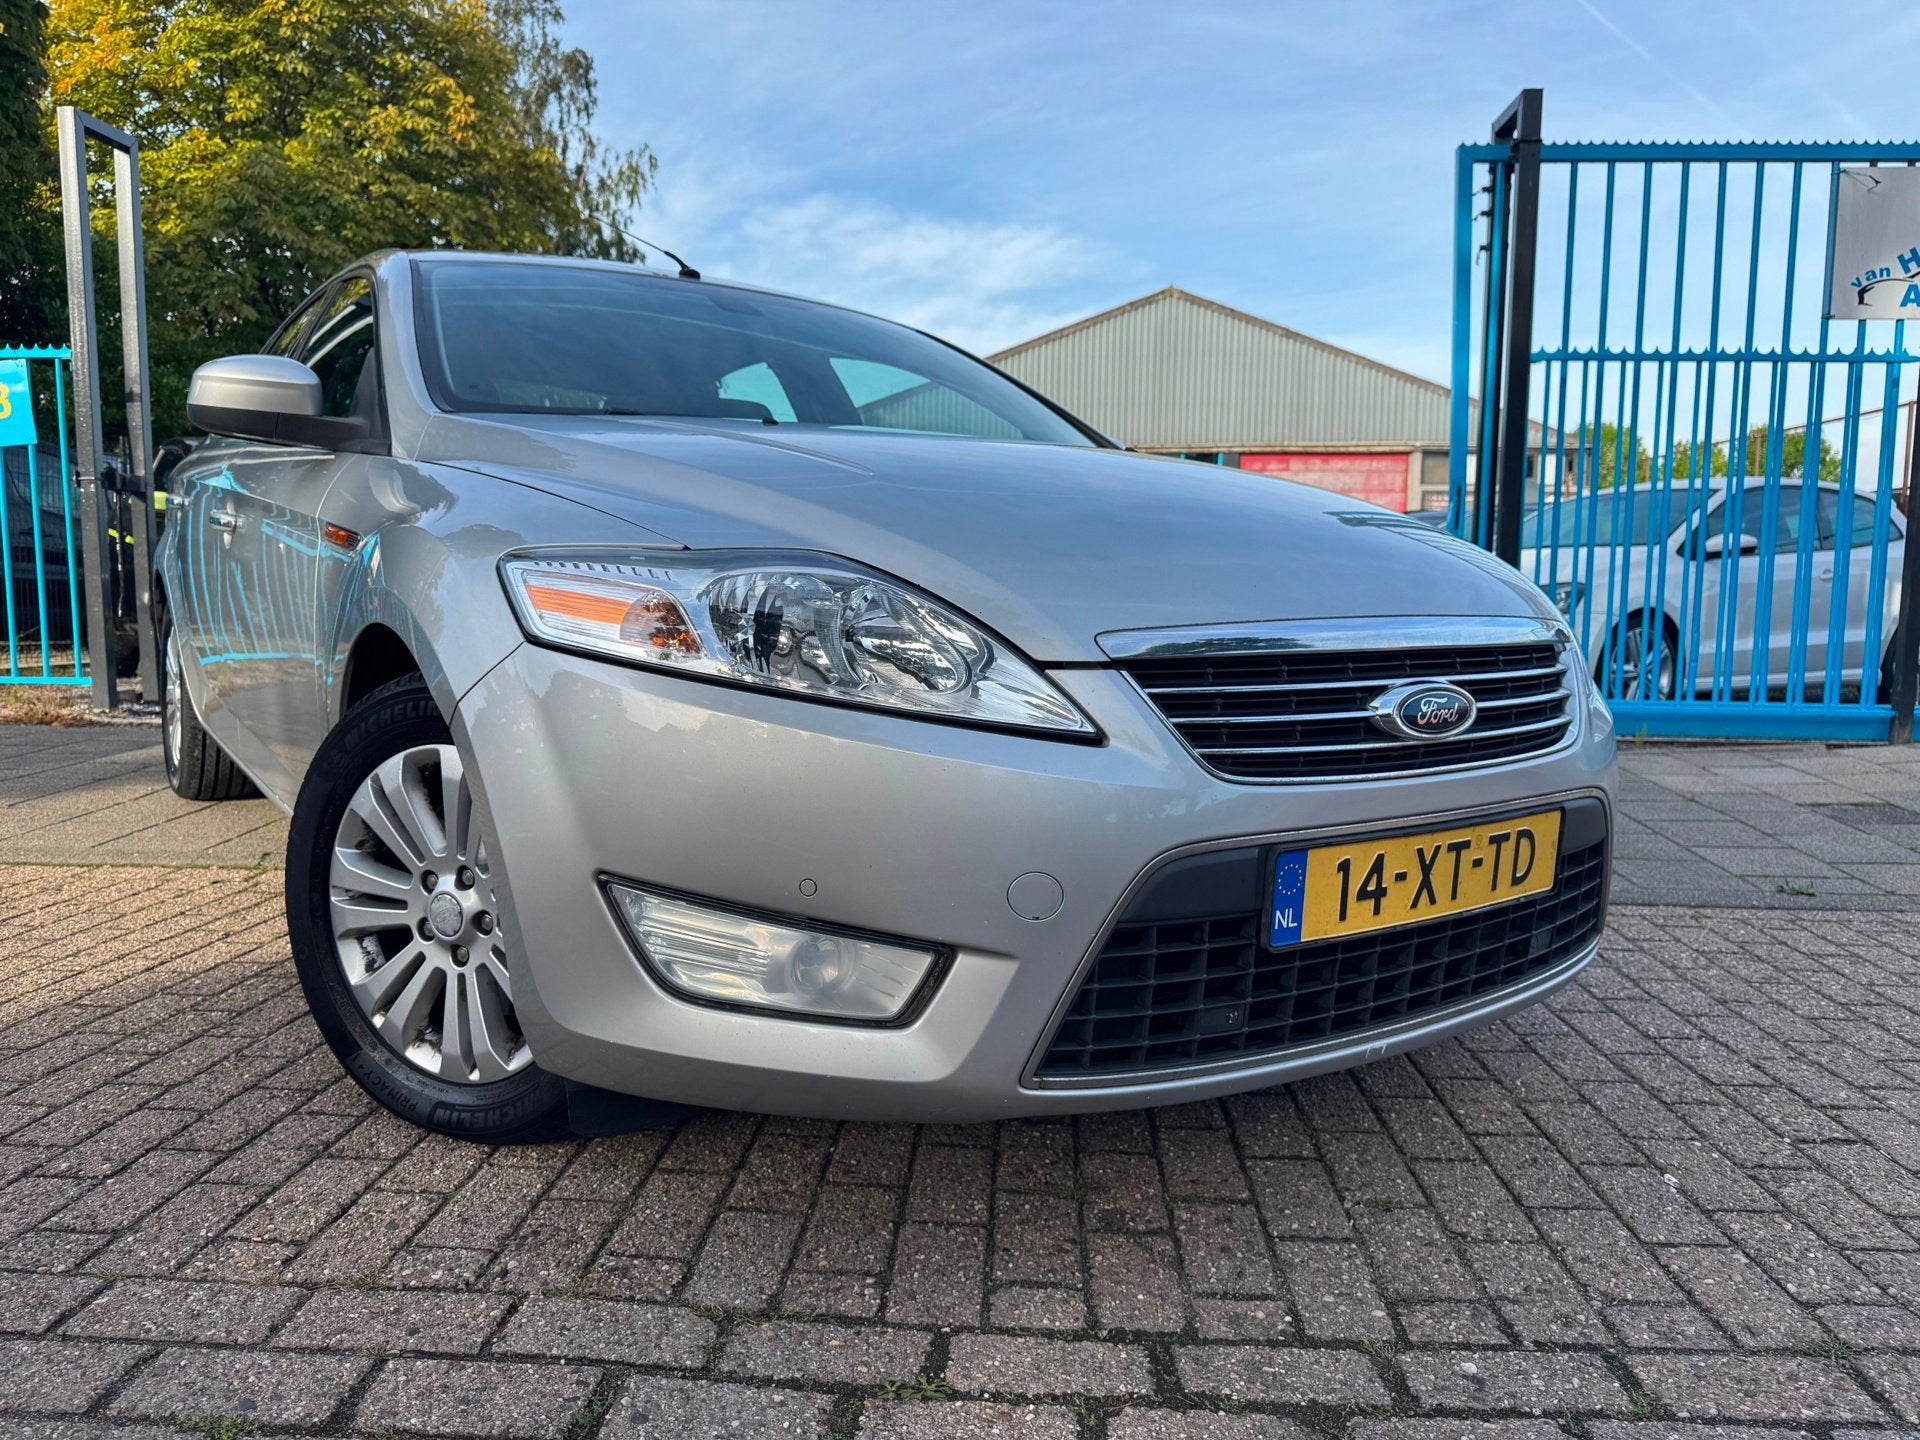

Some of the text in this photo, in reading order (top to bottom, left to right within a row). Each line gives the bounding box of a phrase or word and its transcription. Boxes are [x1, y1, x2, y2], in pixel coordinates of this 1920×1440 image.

[1417, 697, 1459, 725] Ford
[1336, 827, 1536, 922] 14-XT-TD
[1274, 909, 1298, 930] NL
[363, 1070, 419, 1112] PRIMACY
